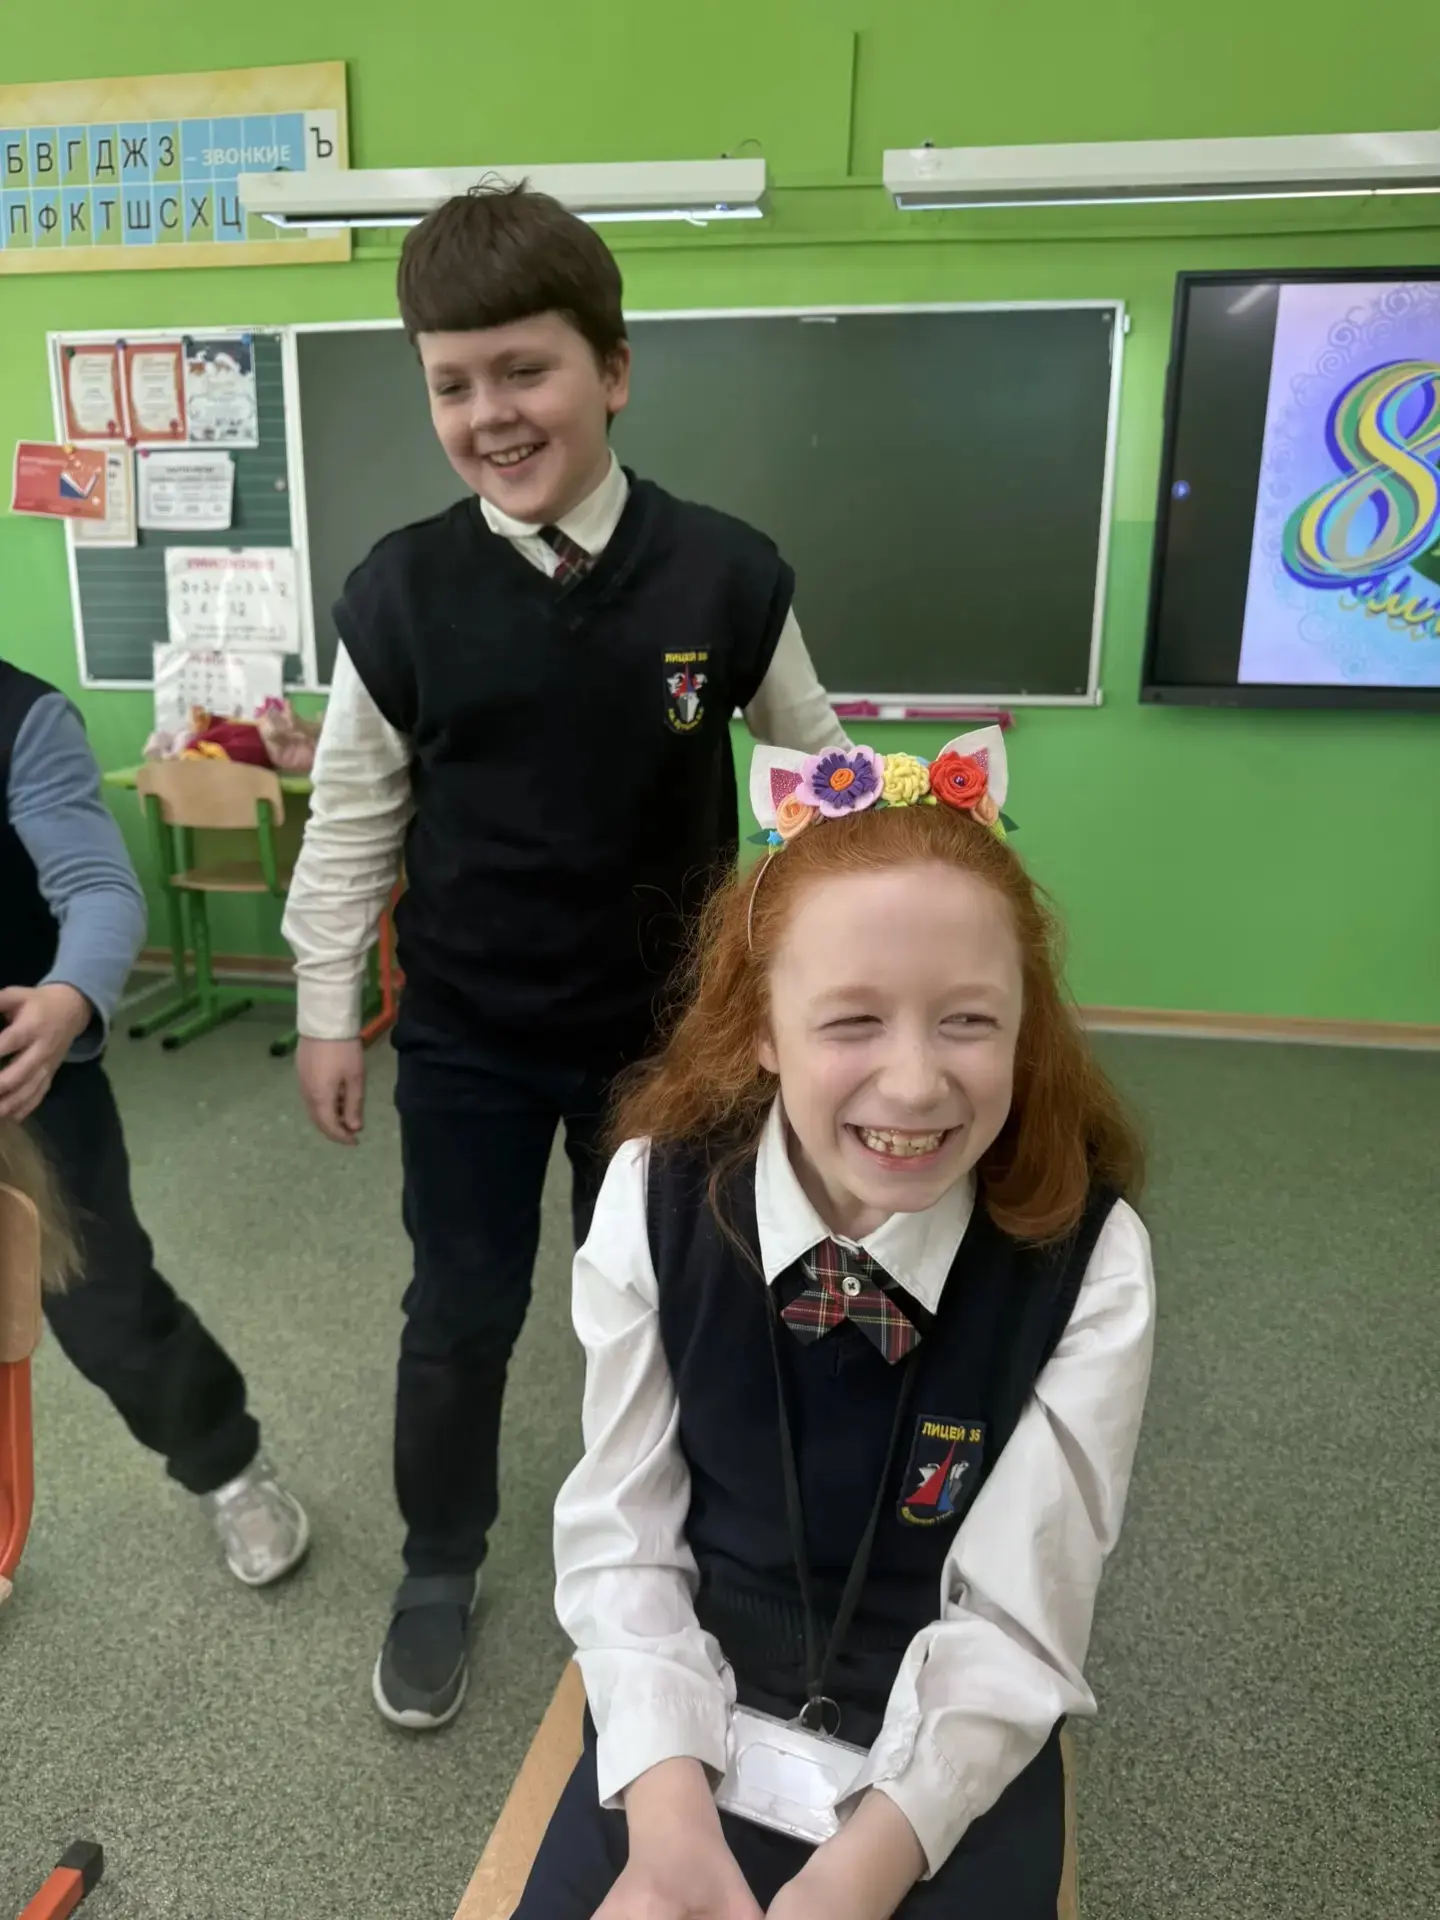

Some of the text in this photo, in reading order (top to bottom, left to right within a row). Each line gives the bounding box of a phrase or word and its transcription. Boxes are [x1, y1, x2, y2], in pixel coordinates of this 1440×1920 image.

[7, 144, 23, 173] Б
[36, 142, 53, 172] В
[67, 140, 81, 171] Г
[95, 139, 115, 176] Д
[121, 137, 149, 169] Ж
[158, 135, 174, 167] З
[201, 144, 291, 166] ЗВОНКИЕ
[310, 127, 333, 158] Ъ
[10, 196, 242, 233] П Ф К Т Ш С Х Ц
[1282, 359, 1440, 590] 8
[922, 1421, 965, 1441] ЛИЦЕЙ
